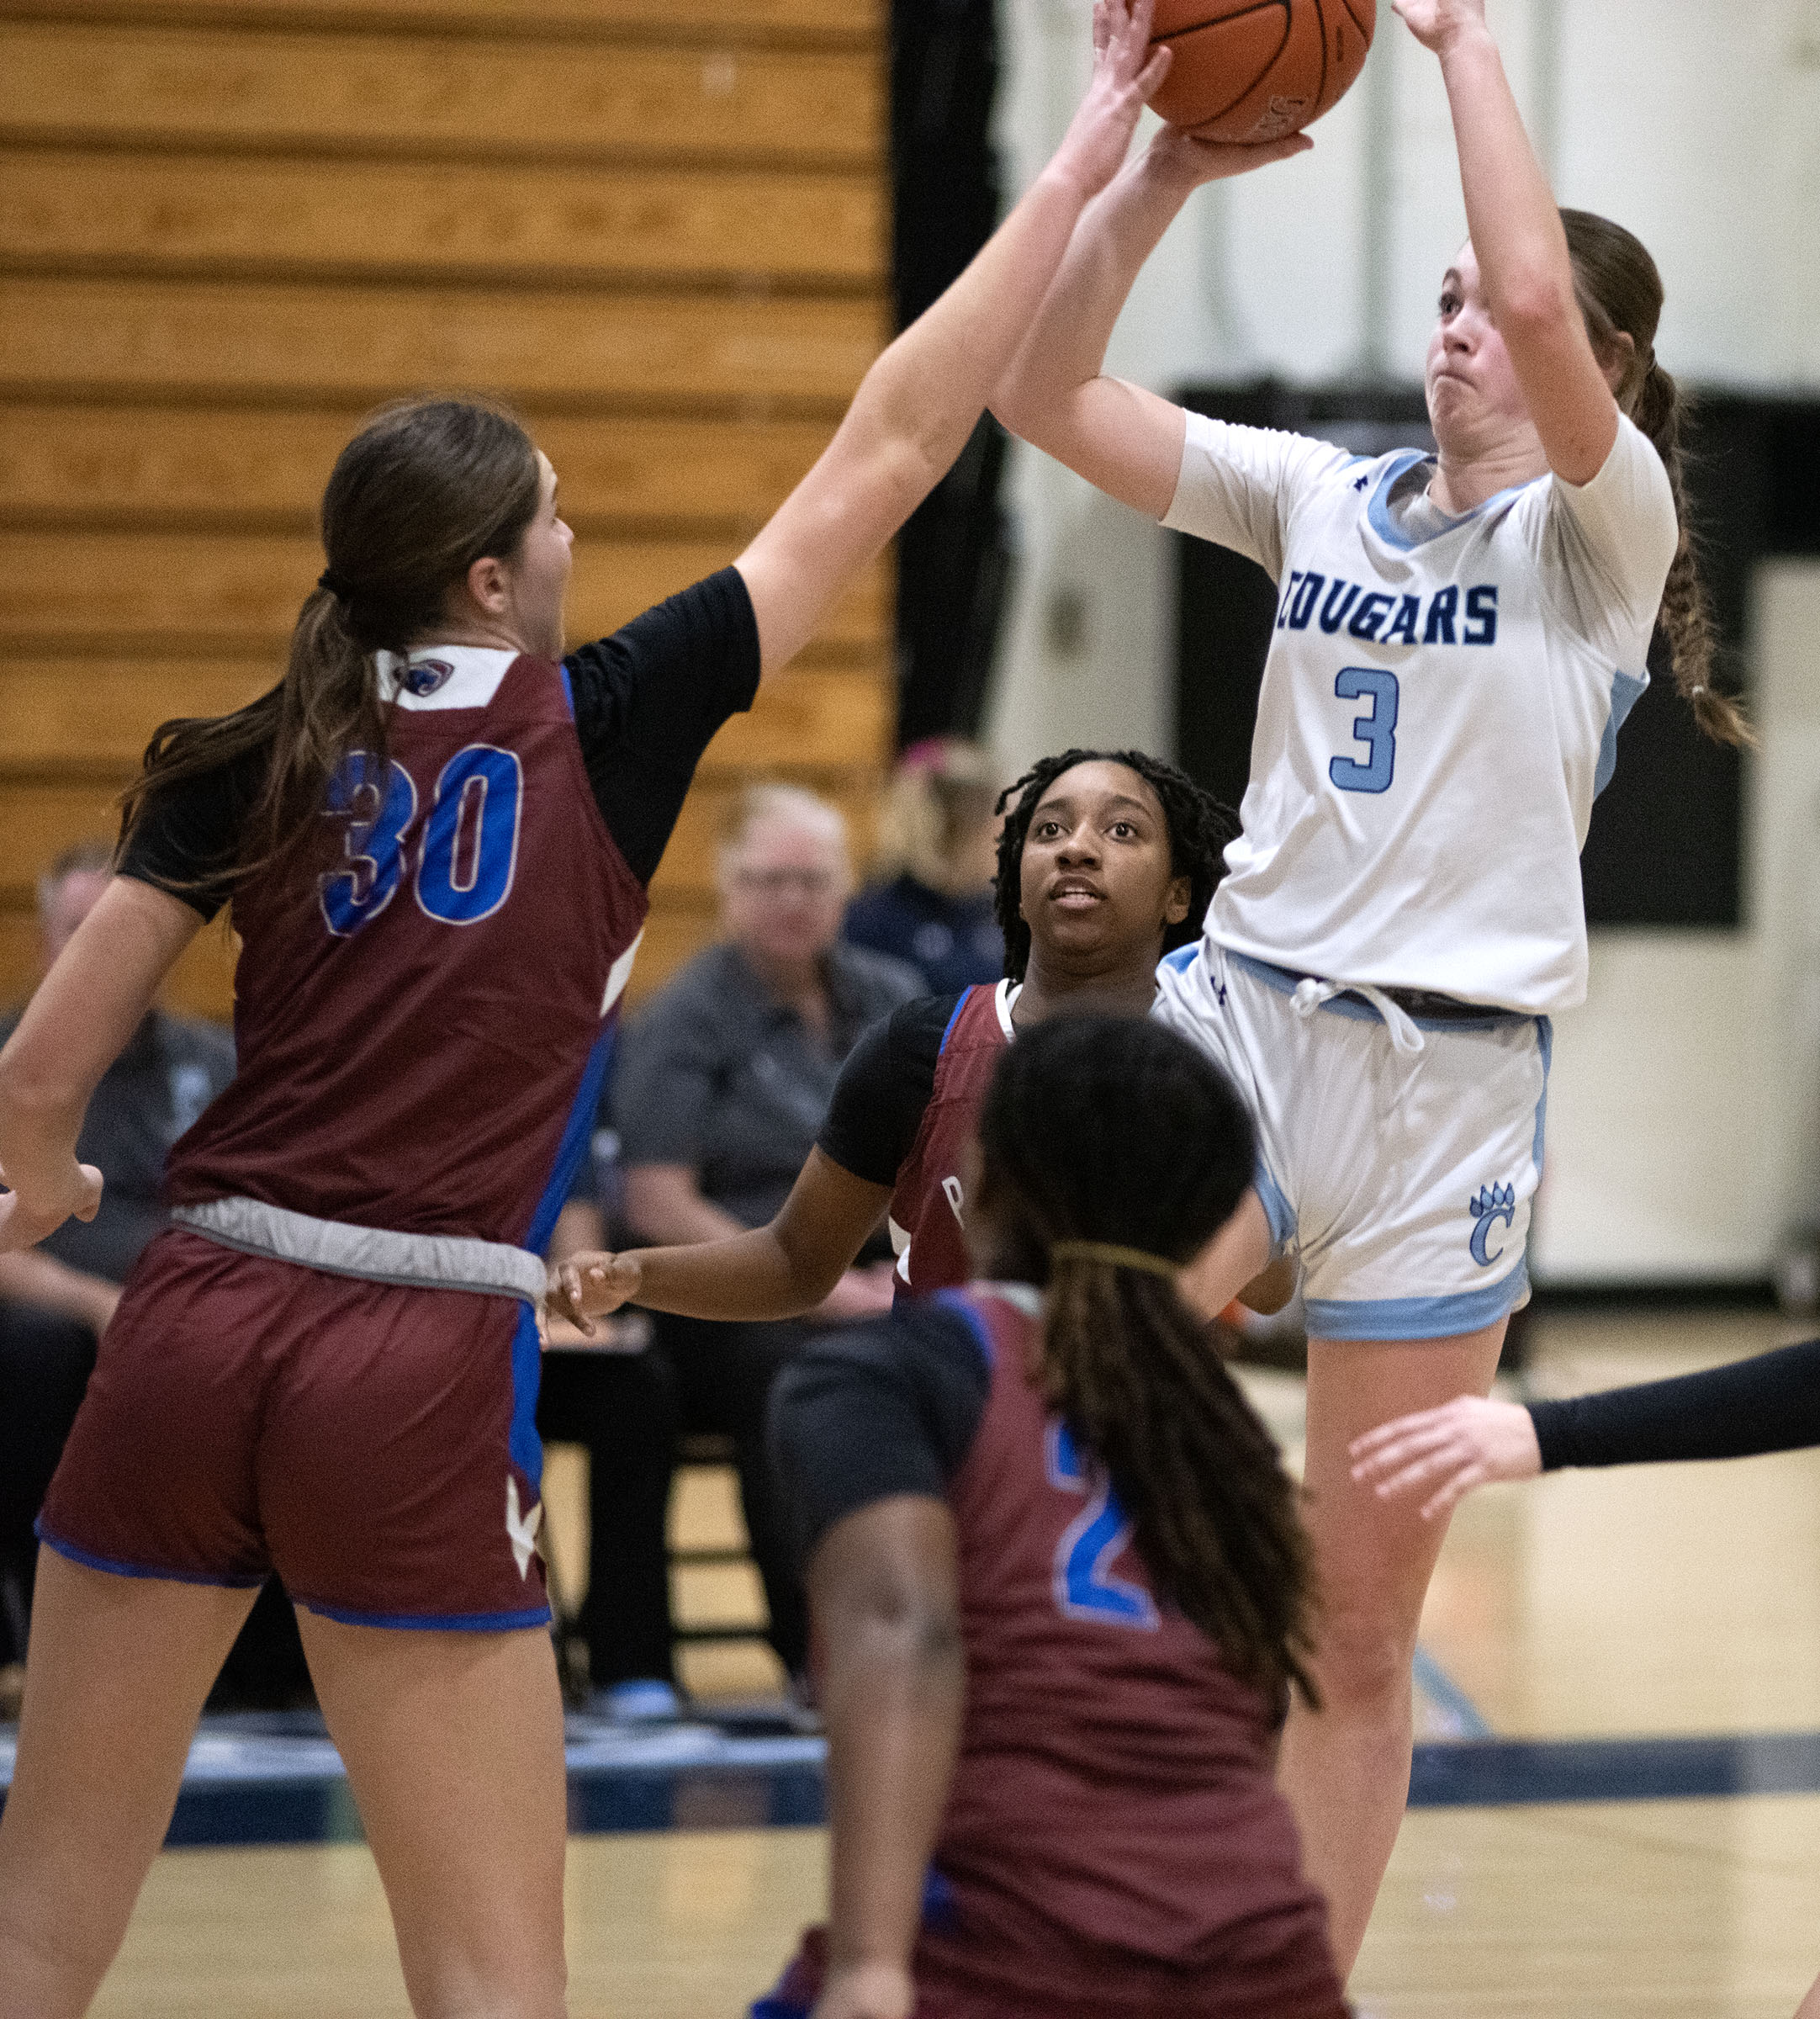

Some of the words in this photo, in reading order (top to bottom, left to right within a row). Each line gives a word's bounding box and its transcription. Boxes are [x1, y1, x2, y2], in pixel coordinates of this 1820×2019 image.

[1329, 665, 1400, 794] 3
[317, 742, 523, 937] 30
[1468, 1205, 1516, 1267] C
[1043, 1416, 1162, 1633] 2
